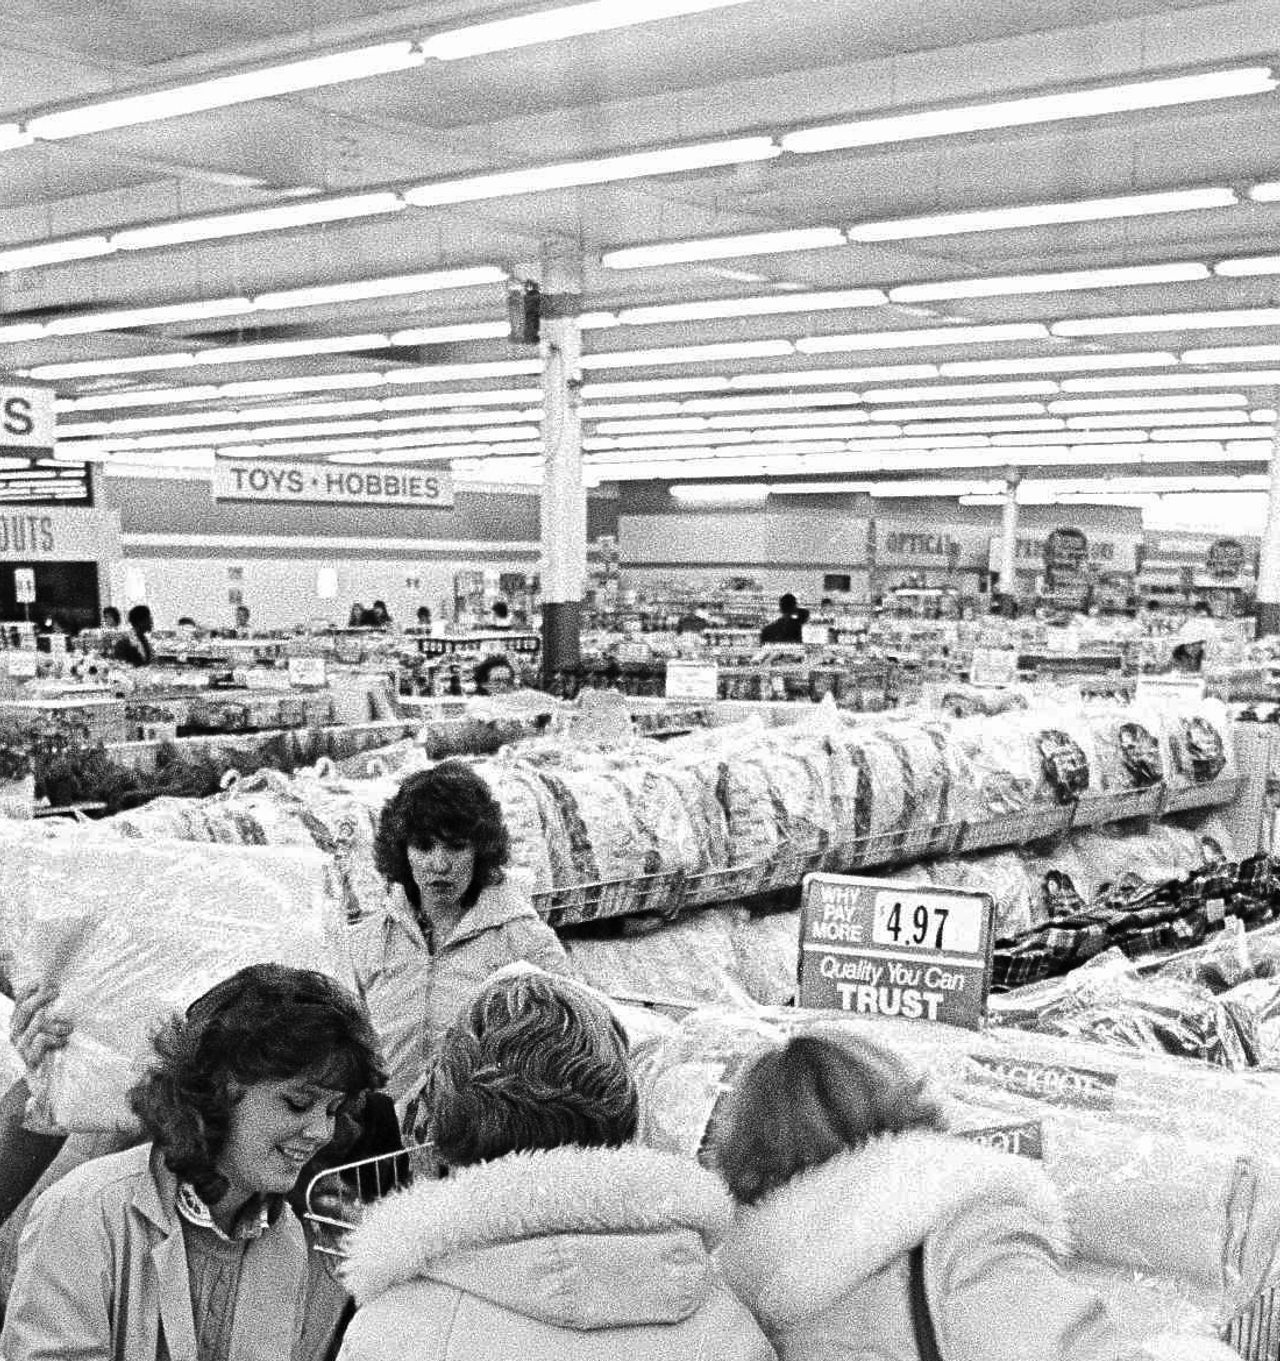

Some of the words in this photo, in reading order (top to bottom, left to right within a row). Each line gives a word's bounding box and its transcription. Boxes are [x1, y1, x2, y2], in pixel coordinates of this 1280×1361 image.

[231, 467, 301, 491] TOYS
[328, 470, 439, 498] HOBBIES
[821, 886, 861, 904] WHY
[824, 904, 855, 921] PAY
[812, 921, 863, 941] MORE
[821, 956, 883, 986] Quality
[888, 963, 921, 986] You
[925, 967, 964, 990] Can
[837, 982, 944, 1020] TRUST
